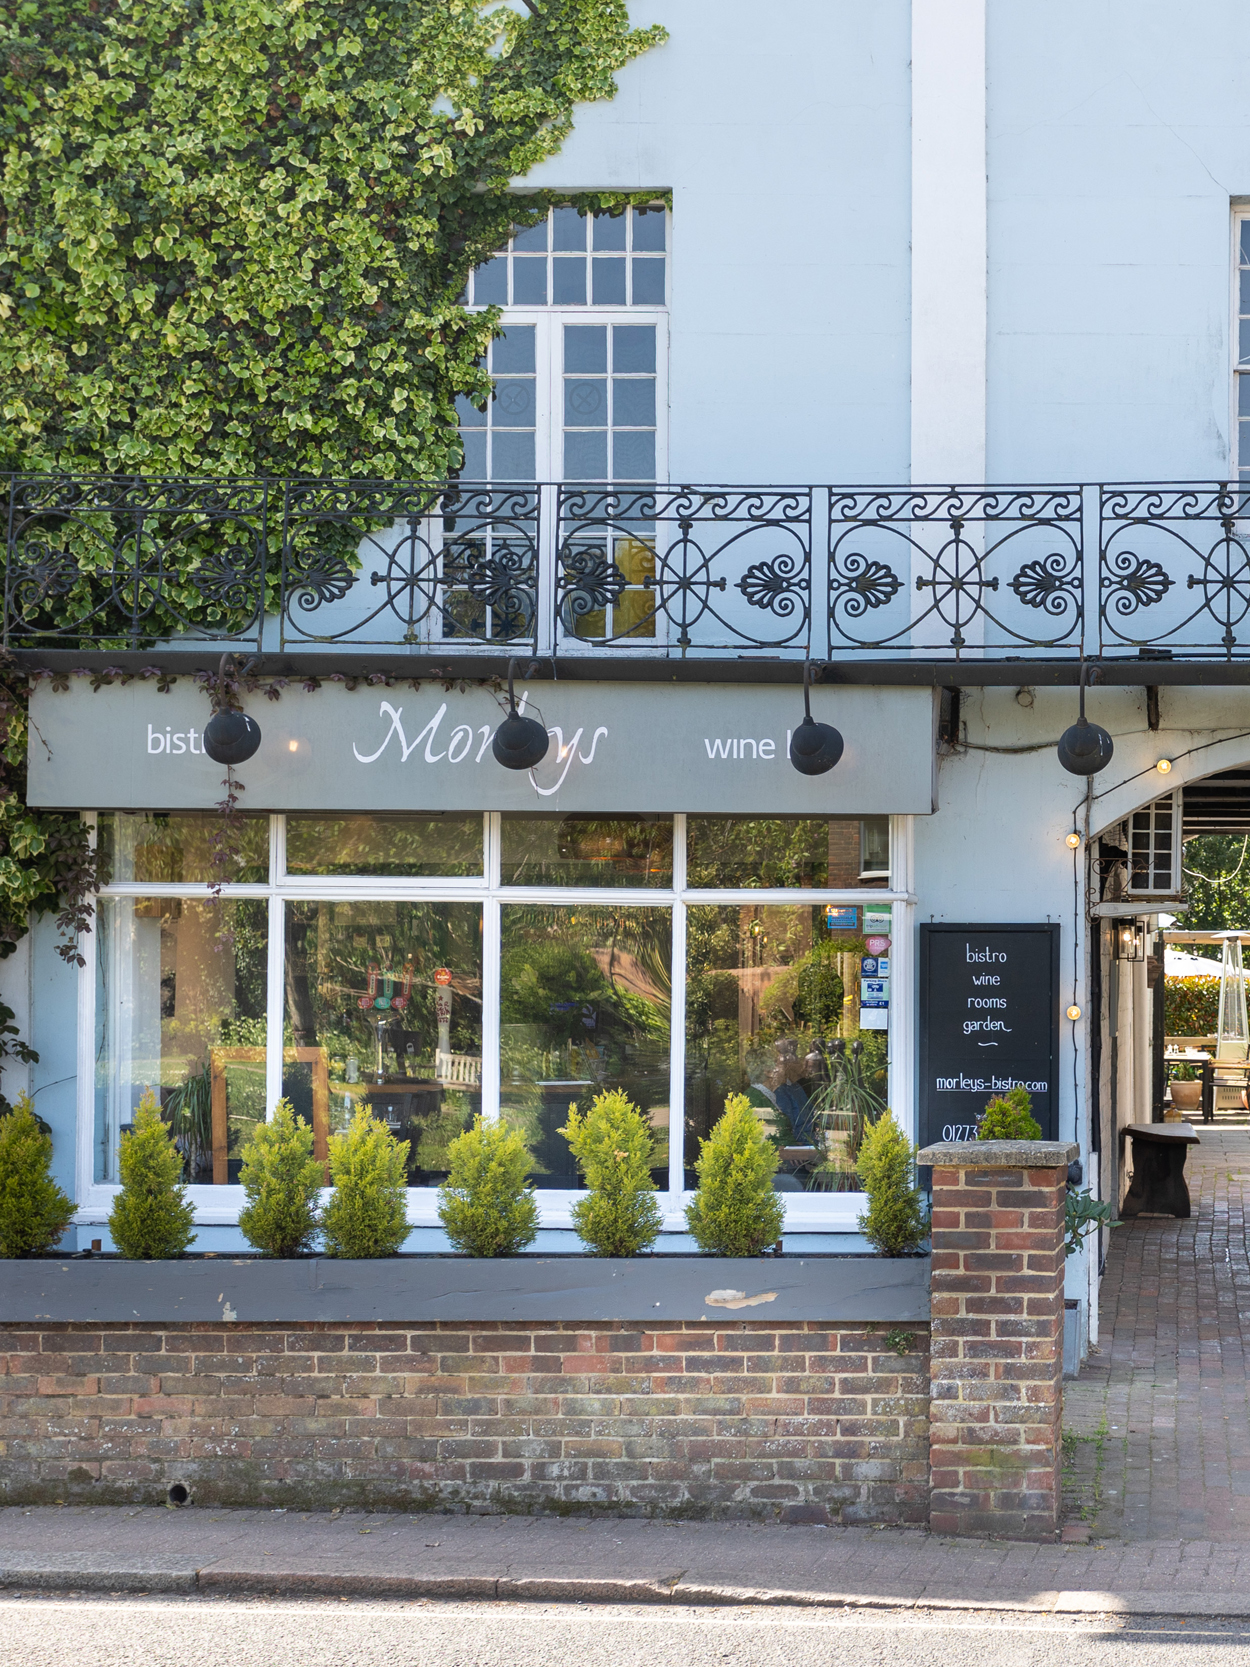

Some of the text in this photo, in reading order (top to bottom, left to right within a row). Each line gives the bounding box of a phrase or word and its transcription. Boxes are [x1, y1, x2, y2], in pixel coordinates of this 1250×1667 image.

[147, 723, 205, 755] bist
[352, 690, 608, 796] Morys
[703, 738, 776, 760] wine
[869, 939, 886, 947] PRS
[966, 942, 1008, 963] bistro
[972, 972, 1001, 986] wine
[967, 997, 1007, 1009] rooms
[963, 1015, 1013, 1035] garden
[936, 1072, 1048, 1093] morleys-bistrocom
